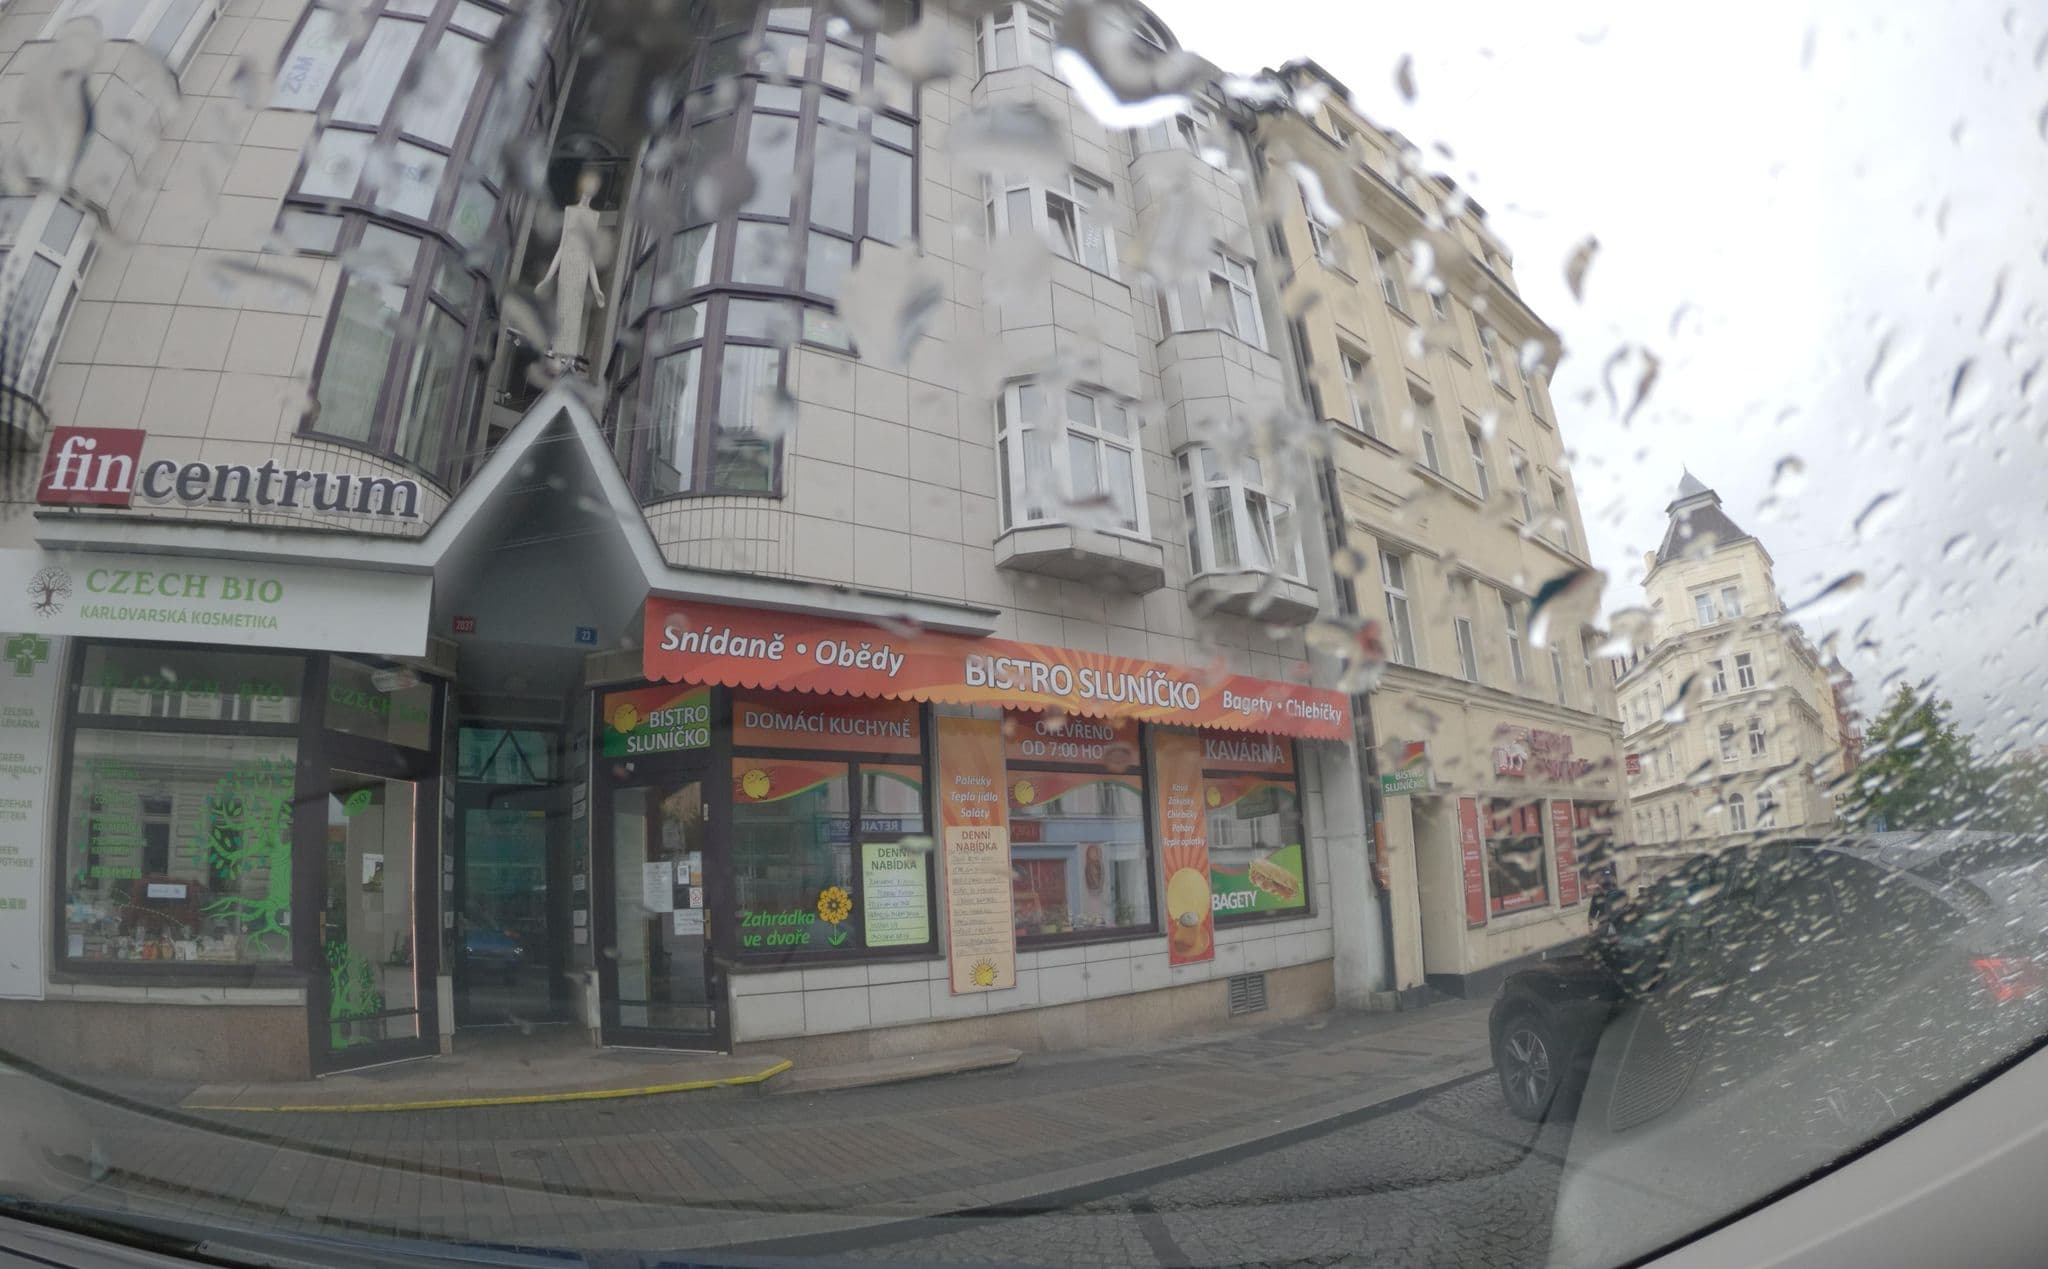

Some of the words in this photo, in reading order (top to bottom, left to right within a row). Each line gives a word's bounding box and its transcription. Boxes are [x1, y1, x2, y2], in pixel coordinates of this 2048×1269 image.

[48, 435, 133, 494] fin
[142, 459, 421, 520] centrum
[86, 568, 206, 599] CZECH
[221, 576, 284, 604] BIO
[80, 604, 187, 625] KARLOVARSKÁ
[191, 610, 279, 631] KOSMETIKA
[661, 625, 786, 661] Snídaně
[815, 639, 905, 678] Obědy
[965, 654, 1074, 697] BISTRO
[1079, 668, 1200, 711] SLUNÍČKO
[649, 704, 709, 729] BISTRO
[1222, 690, 1273, 717] Bagety
[1285, 699, 1342, 727] Chlebíčky
[744, 711, 824, 733] DOMÁCÍ
[829, 716, 912, 738] KUCHYNĚ
[627, 726, 709, 753] SLUNÍČKO
[1022, 740, 1046, 756] OD
[1049, 742, 1079, 758] 7:00
[1206, 737, 1286, 765] KAVÁRNA
[960, 808, 990, 819] Saláty
[956, 840, 998, 852] NABÍDKA
[962, 828, 991, 840] DENNÍ
[871, 858, 918, 871] NABÍDKA
[1211, 890, 1258, 911] BAGETY
[742, 911, 815, 928] Zahrádka
[743, 935, 762, 947] ve
[767, 931, 811, 946] dvoře
